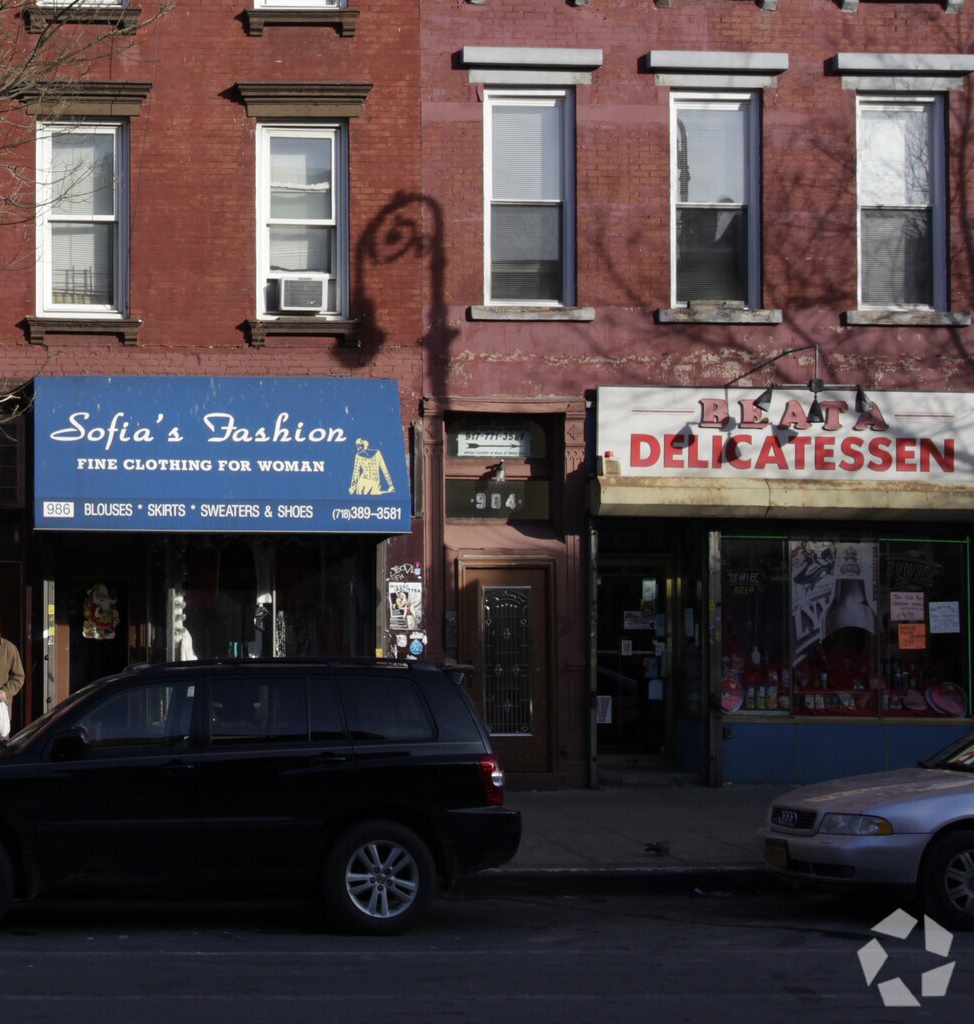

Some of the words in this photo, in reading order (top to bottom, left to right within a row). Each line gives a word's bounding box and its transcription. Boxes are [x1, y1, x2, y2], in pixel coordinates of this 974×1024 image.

[50, 411, 184, 450] Sofia's
[204, 412, 347, 443] Fashion
[698, 398, 889, 431] BEATA
[77, 458, 118, 471] FINE
[123, 459, 213, 472] CLOTHING
[217, 459, 252, 472] FOR
[258, 460, 326, 473] WOMAN
[629, 433, 955, 473] DELICATESSEN
[46, 502, 71, 517] 986
[84, 503, 133, 517] BLOUSES
[148, 504, 186, 518] SKIRTS
[201, 504, 260, 518] SWEATERS
[264, 505, 273, 518] &
[278, 505, 314, 519] SHOES
